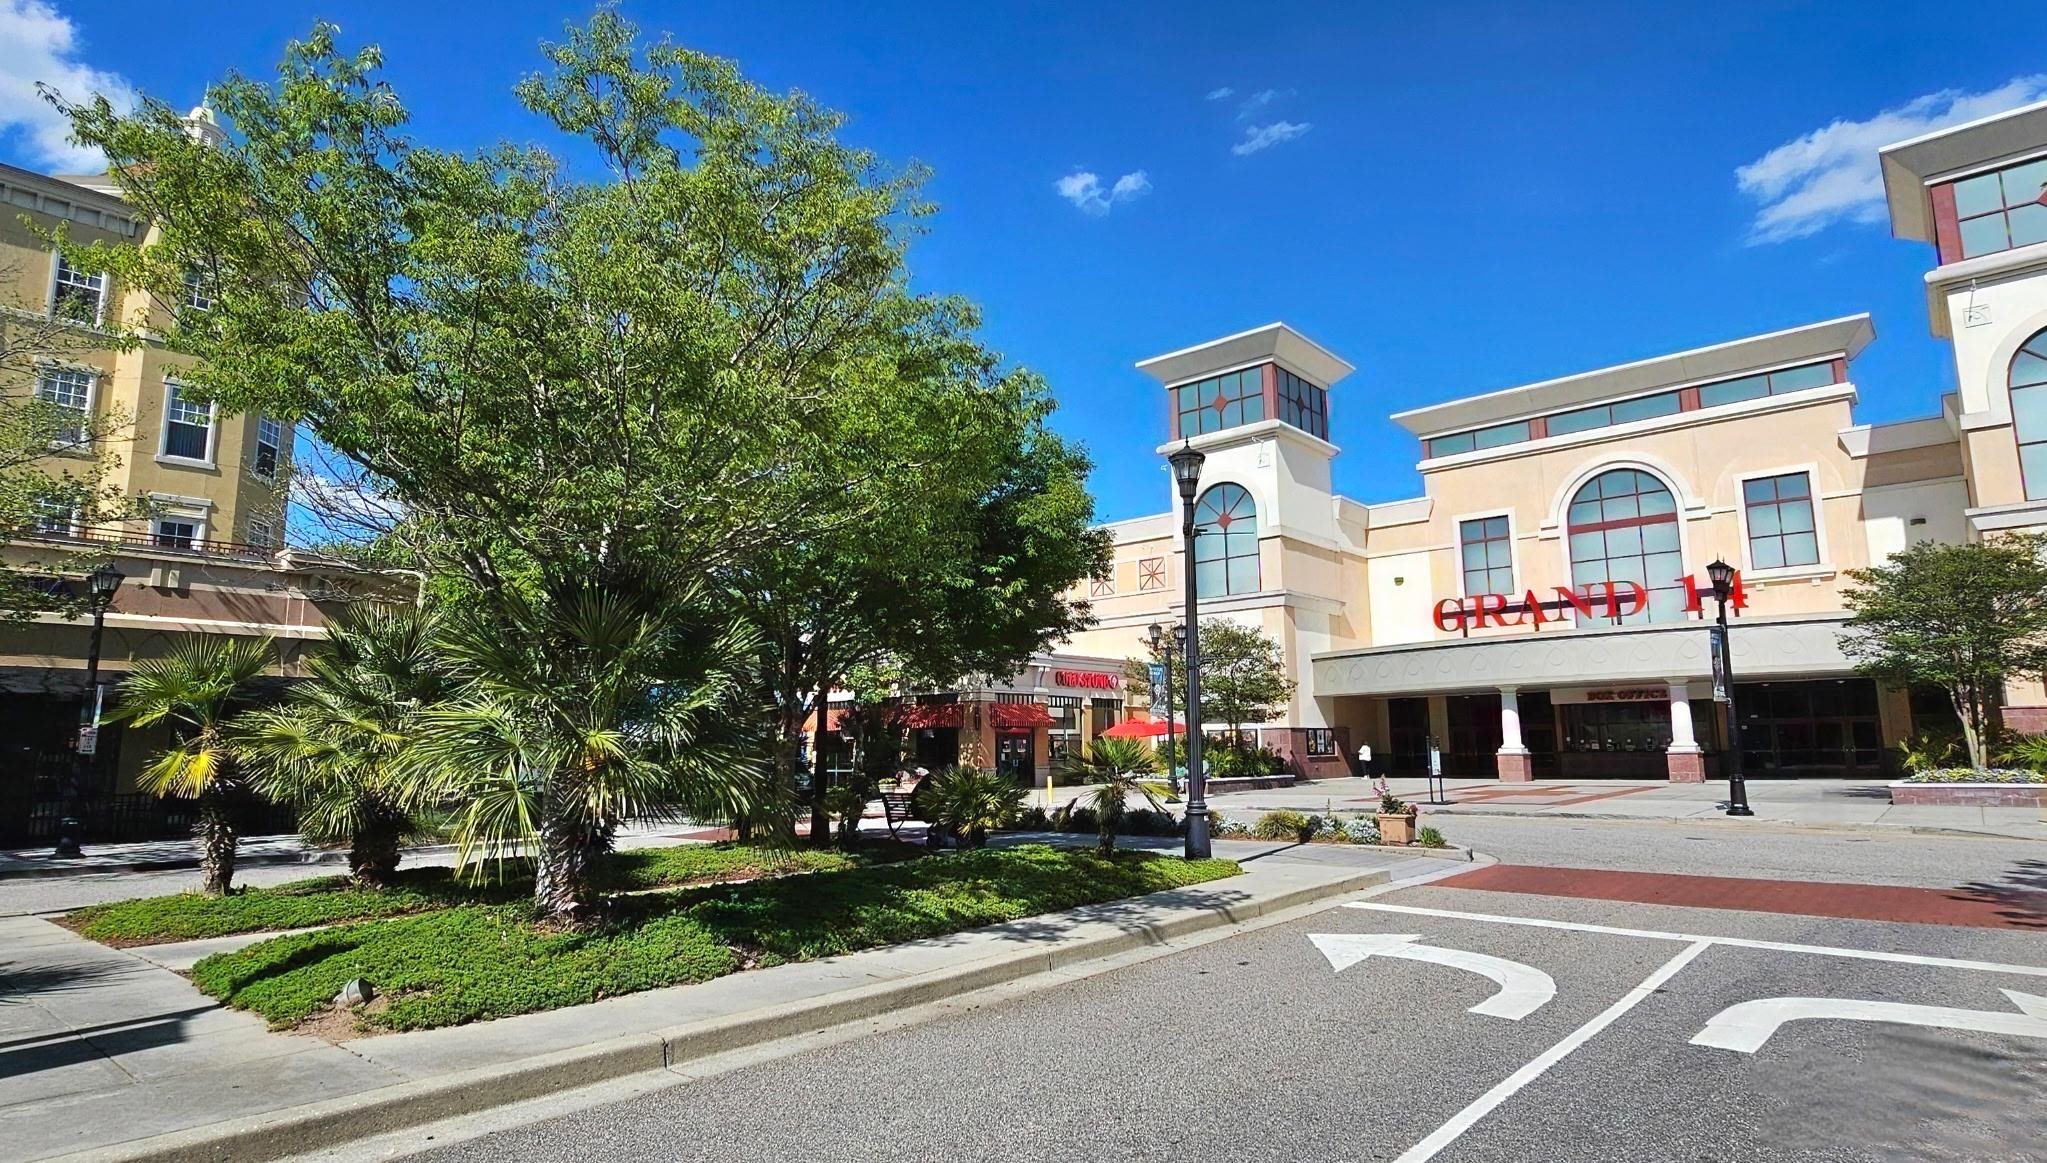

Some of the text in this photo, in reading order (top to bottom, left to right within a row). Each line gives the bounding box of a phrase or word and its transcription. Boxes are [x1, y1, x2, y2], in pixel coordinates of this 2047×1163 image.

[1433, 580, 1648, 632] GRAND
[1587, 689, 1668, 701] BOX OFFICE
